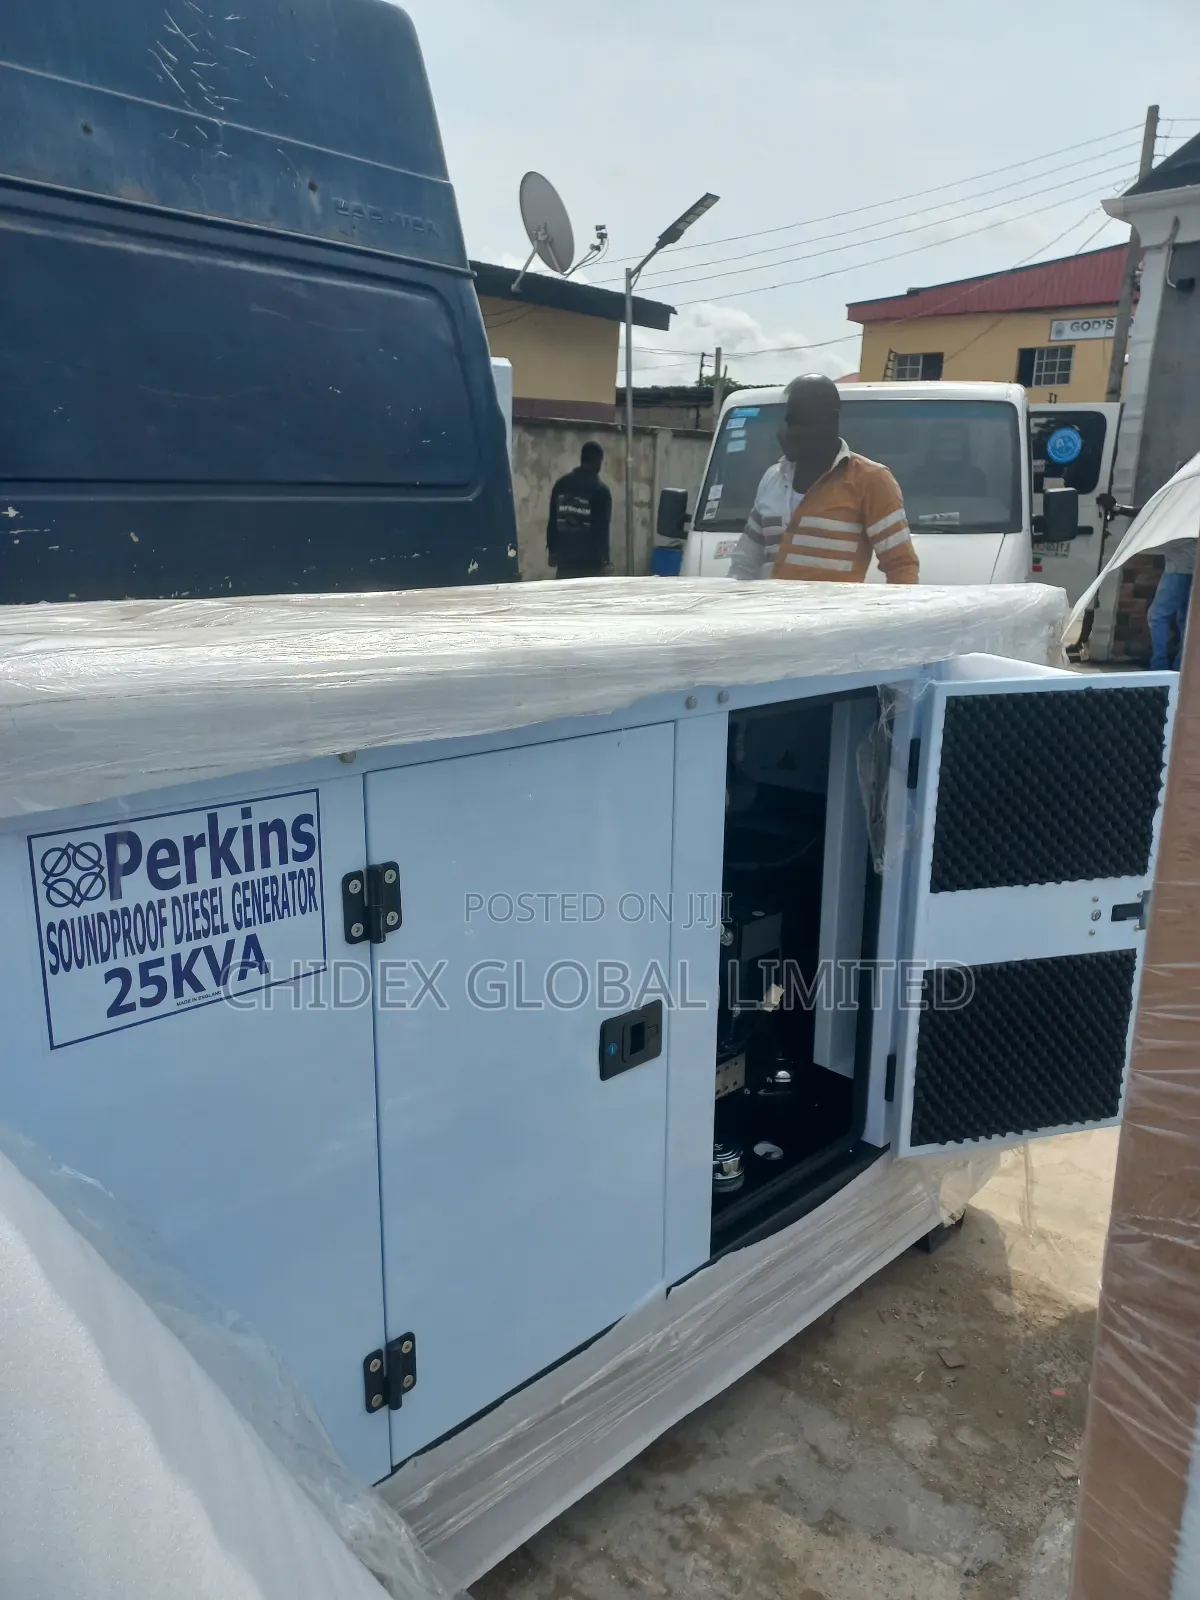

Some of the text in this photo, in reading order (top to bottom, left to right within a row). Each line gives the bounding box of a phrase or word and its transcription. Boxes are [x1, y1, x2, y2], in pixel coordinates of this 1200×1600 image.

[1070, 319, 1114, 332] GOD'S
[104, 807, 317, 901] Perkins
[46, 867, 319, 976] SOUNDPROOF DIESEL GENERATOR
[104, 933, 270, 1019] 25KVA
[198, 990, 221, 1001] ENGLAND
